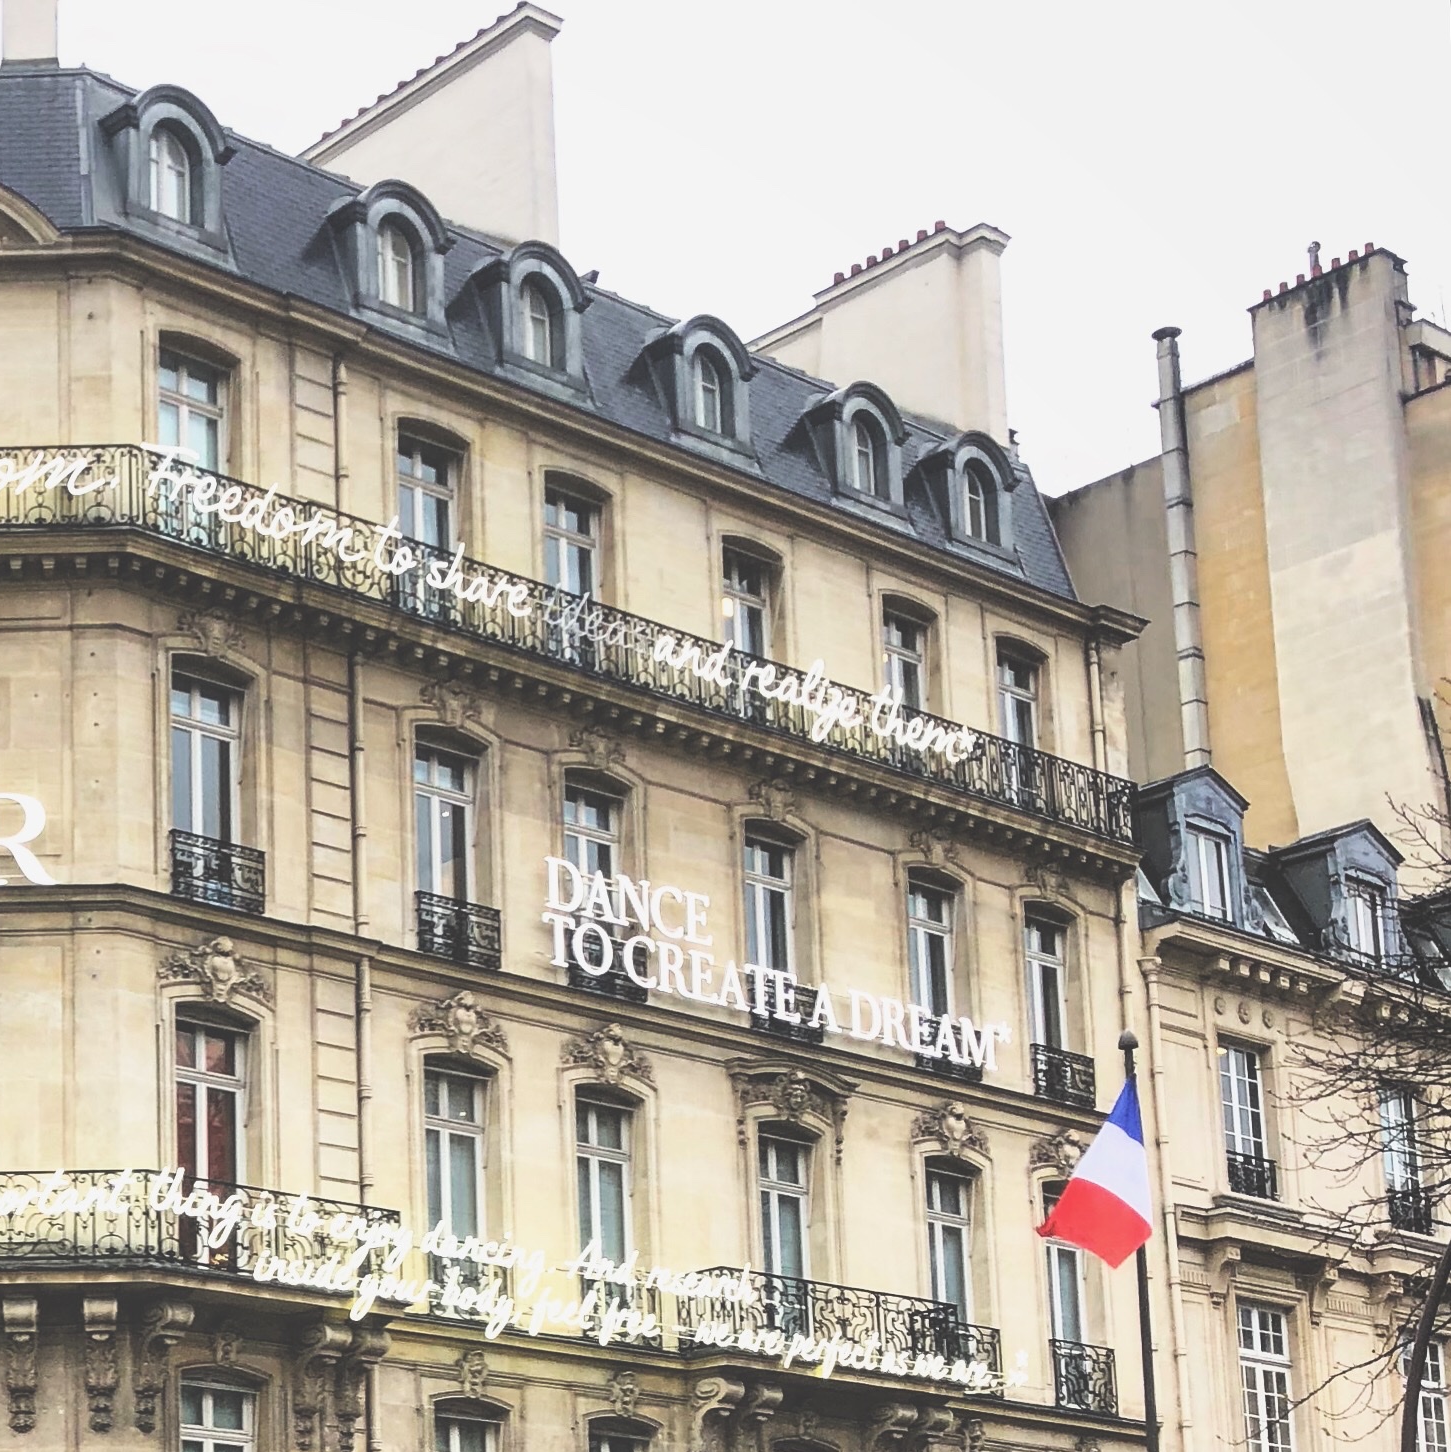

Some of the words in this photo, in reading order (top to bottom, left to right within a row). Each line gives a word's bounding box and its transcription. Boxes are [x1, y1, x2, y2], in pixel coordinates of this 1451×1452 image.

[140, 442, 365, 562] Freedom
[372, 515, 417, 575] to
[425, 543, 532, 617] share
[653, 632, 733, 686] and
[741, 659, 864, 741] realize
[544, 856, 713, 947] DANCE
[542, 911, 613, 976] TO
[623, 935, 800, 1023] CREATE
[812, 983, 843, 1033] A
[150, 1166, 242, 1247] thing
[251, 1190, 277, 1230] is
[284, 1190, 324, 1234] to
[330, 1208, 414, 1272] enjoy
[565, 1238, 641, 1286] And
[252, 1249, 360, 1291] inside
[349, 1272, 443, 1321] your
[784, 1331, 881, 1379] perfect
